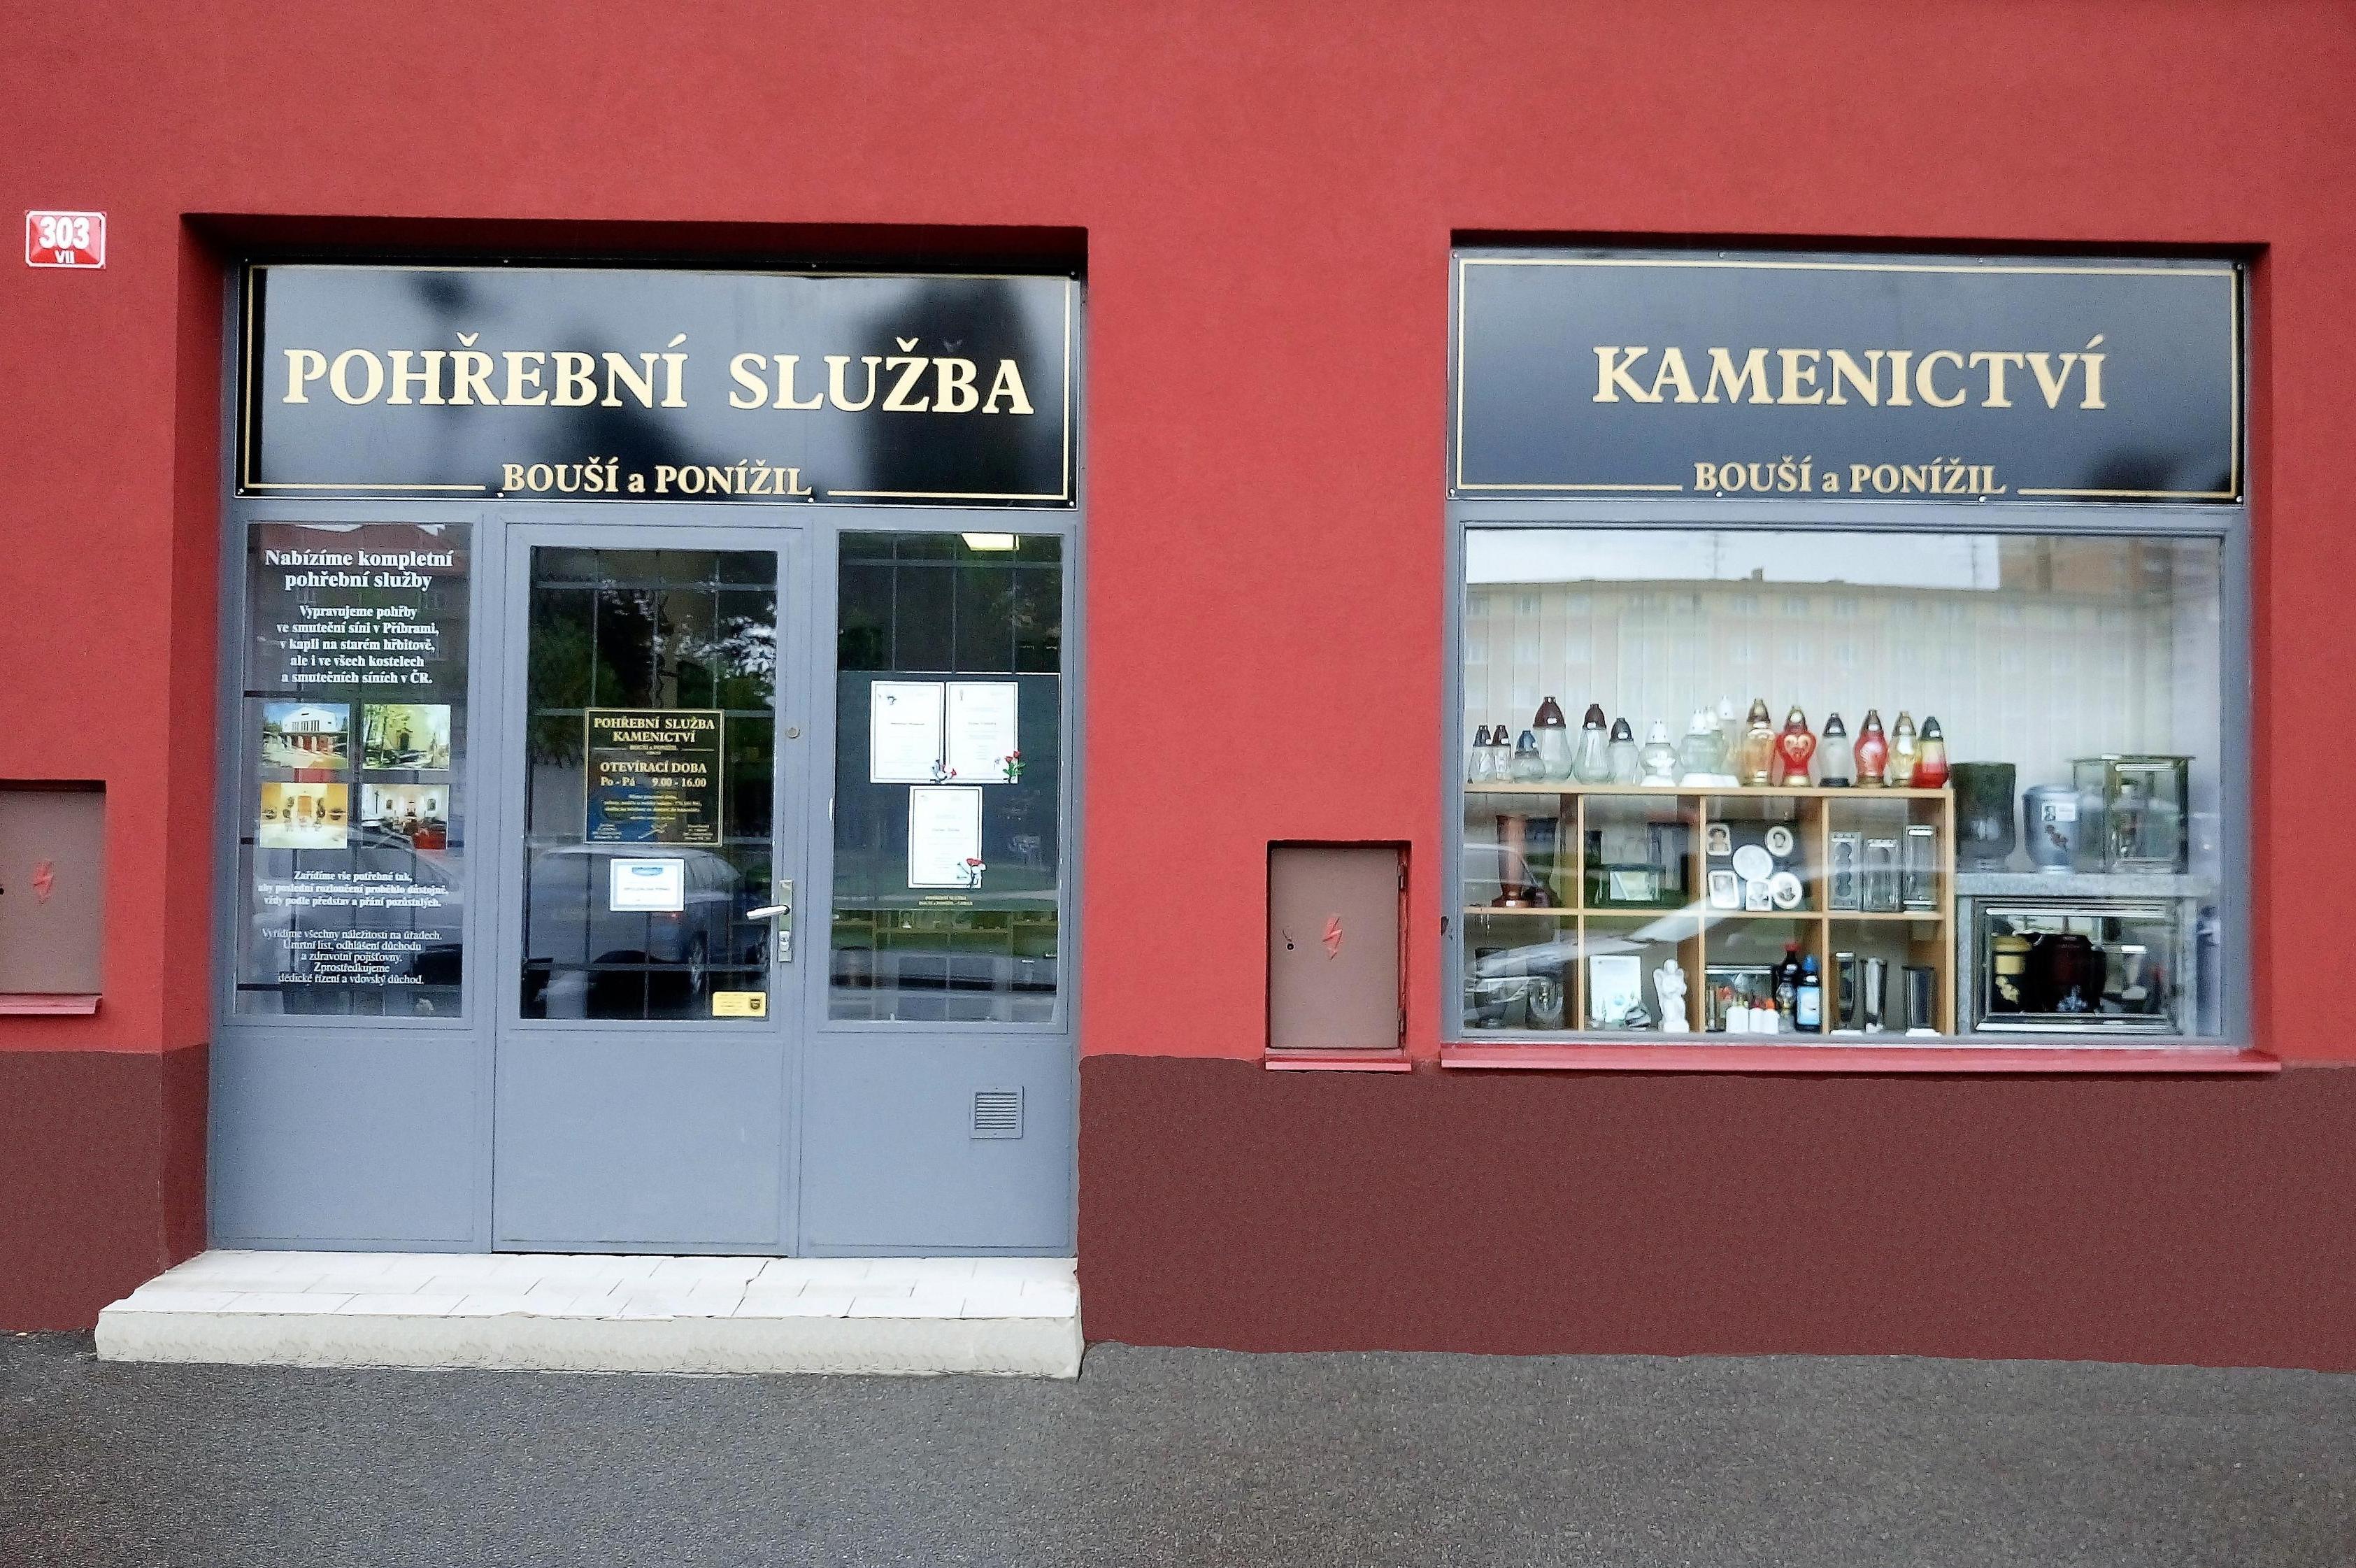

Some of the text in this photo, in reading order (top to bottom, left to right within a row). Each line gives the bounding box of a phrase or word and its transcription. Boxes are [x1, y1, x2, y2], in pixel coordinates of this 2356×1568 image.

[38, 216, 90, 249] 303
[55, 250, 75, 264] VII
[283, 332, 1035, 415] POHŘEBNÍ SLUŽBA
[1592, 334, 2106, 410] KAMENICTVÍ
[502, 457, 812, 496] BOUŠÍ a PONÍŽIL
[1694, 455, 2006, 495] BOUŠÍ a PONÍŽIL
[265, 550, 454, 570] Nabízíme kompletní
[285, 571, 432, 592] pohřební služby
[299, 605, 417, 620] Vypravujeme pohřby
[276, 624, 289, 633] ve
[292, 622, 346, 633] smuteční
[373, 625, 380, 633] v
[383, 622, 439, 636] Příbrami,
[280, 641, 287, 649] v
[290, 638, 319, 652] kapli
[322, 641, 337, 649] na
[341, 638, 380, 650] starém
[290, 655, 424, 667] ale i ve všech kostelech
[281, 669, 433, 684] a smutečních síních v ČR.
[594, 715, 715, 729] POHŘEBNÍ SLUŽBA
[613, 730, 696, 743] KAMENICTVÍ
[600, 760, 707, 774] OTEVÍRACÍ DOBA
[600, 777, 613, 786] Po
[622, 776, 635, 787] Pá
[681, 777, 707, 787] 16.00
[309, 951, 352, 961] zdravotní
[350, 974, 386, 985] vdovský
